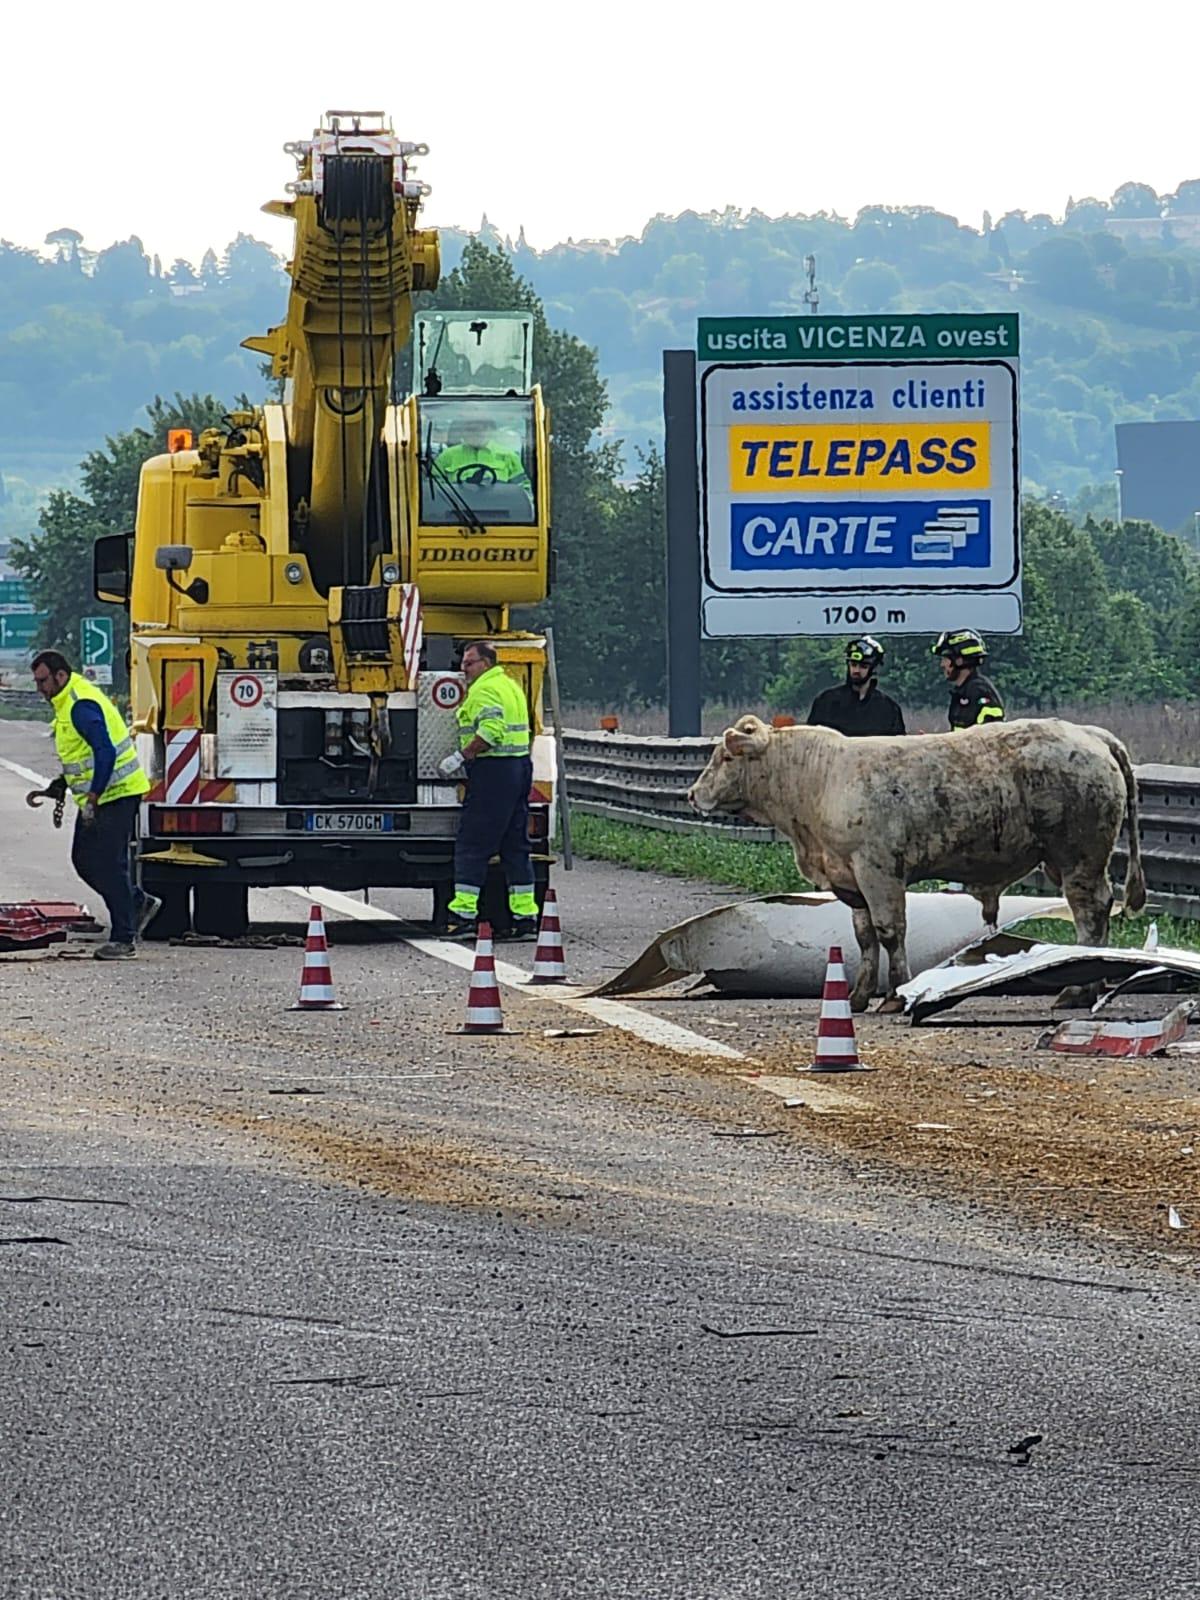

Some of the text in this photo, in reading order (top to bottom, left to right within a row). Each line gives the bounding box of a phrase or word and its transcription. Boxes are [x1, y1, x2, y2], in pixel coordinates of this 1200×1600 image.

[707, 325, 1009, 350] uscita VICENZA ovest
[732, 380, 985, 410] assistenza clienti
[741, 438, 977, 477] TELEPASS
[742, 516, 896, 556] CARTE
[419, 548, 536, 562] IDROGRU
[823, 606, 906, 624] 1700 m
[238, 685, 254, 699] 70
[440, 687, 456, 700] 80
[315, 815, 332, 829] CK
